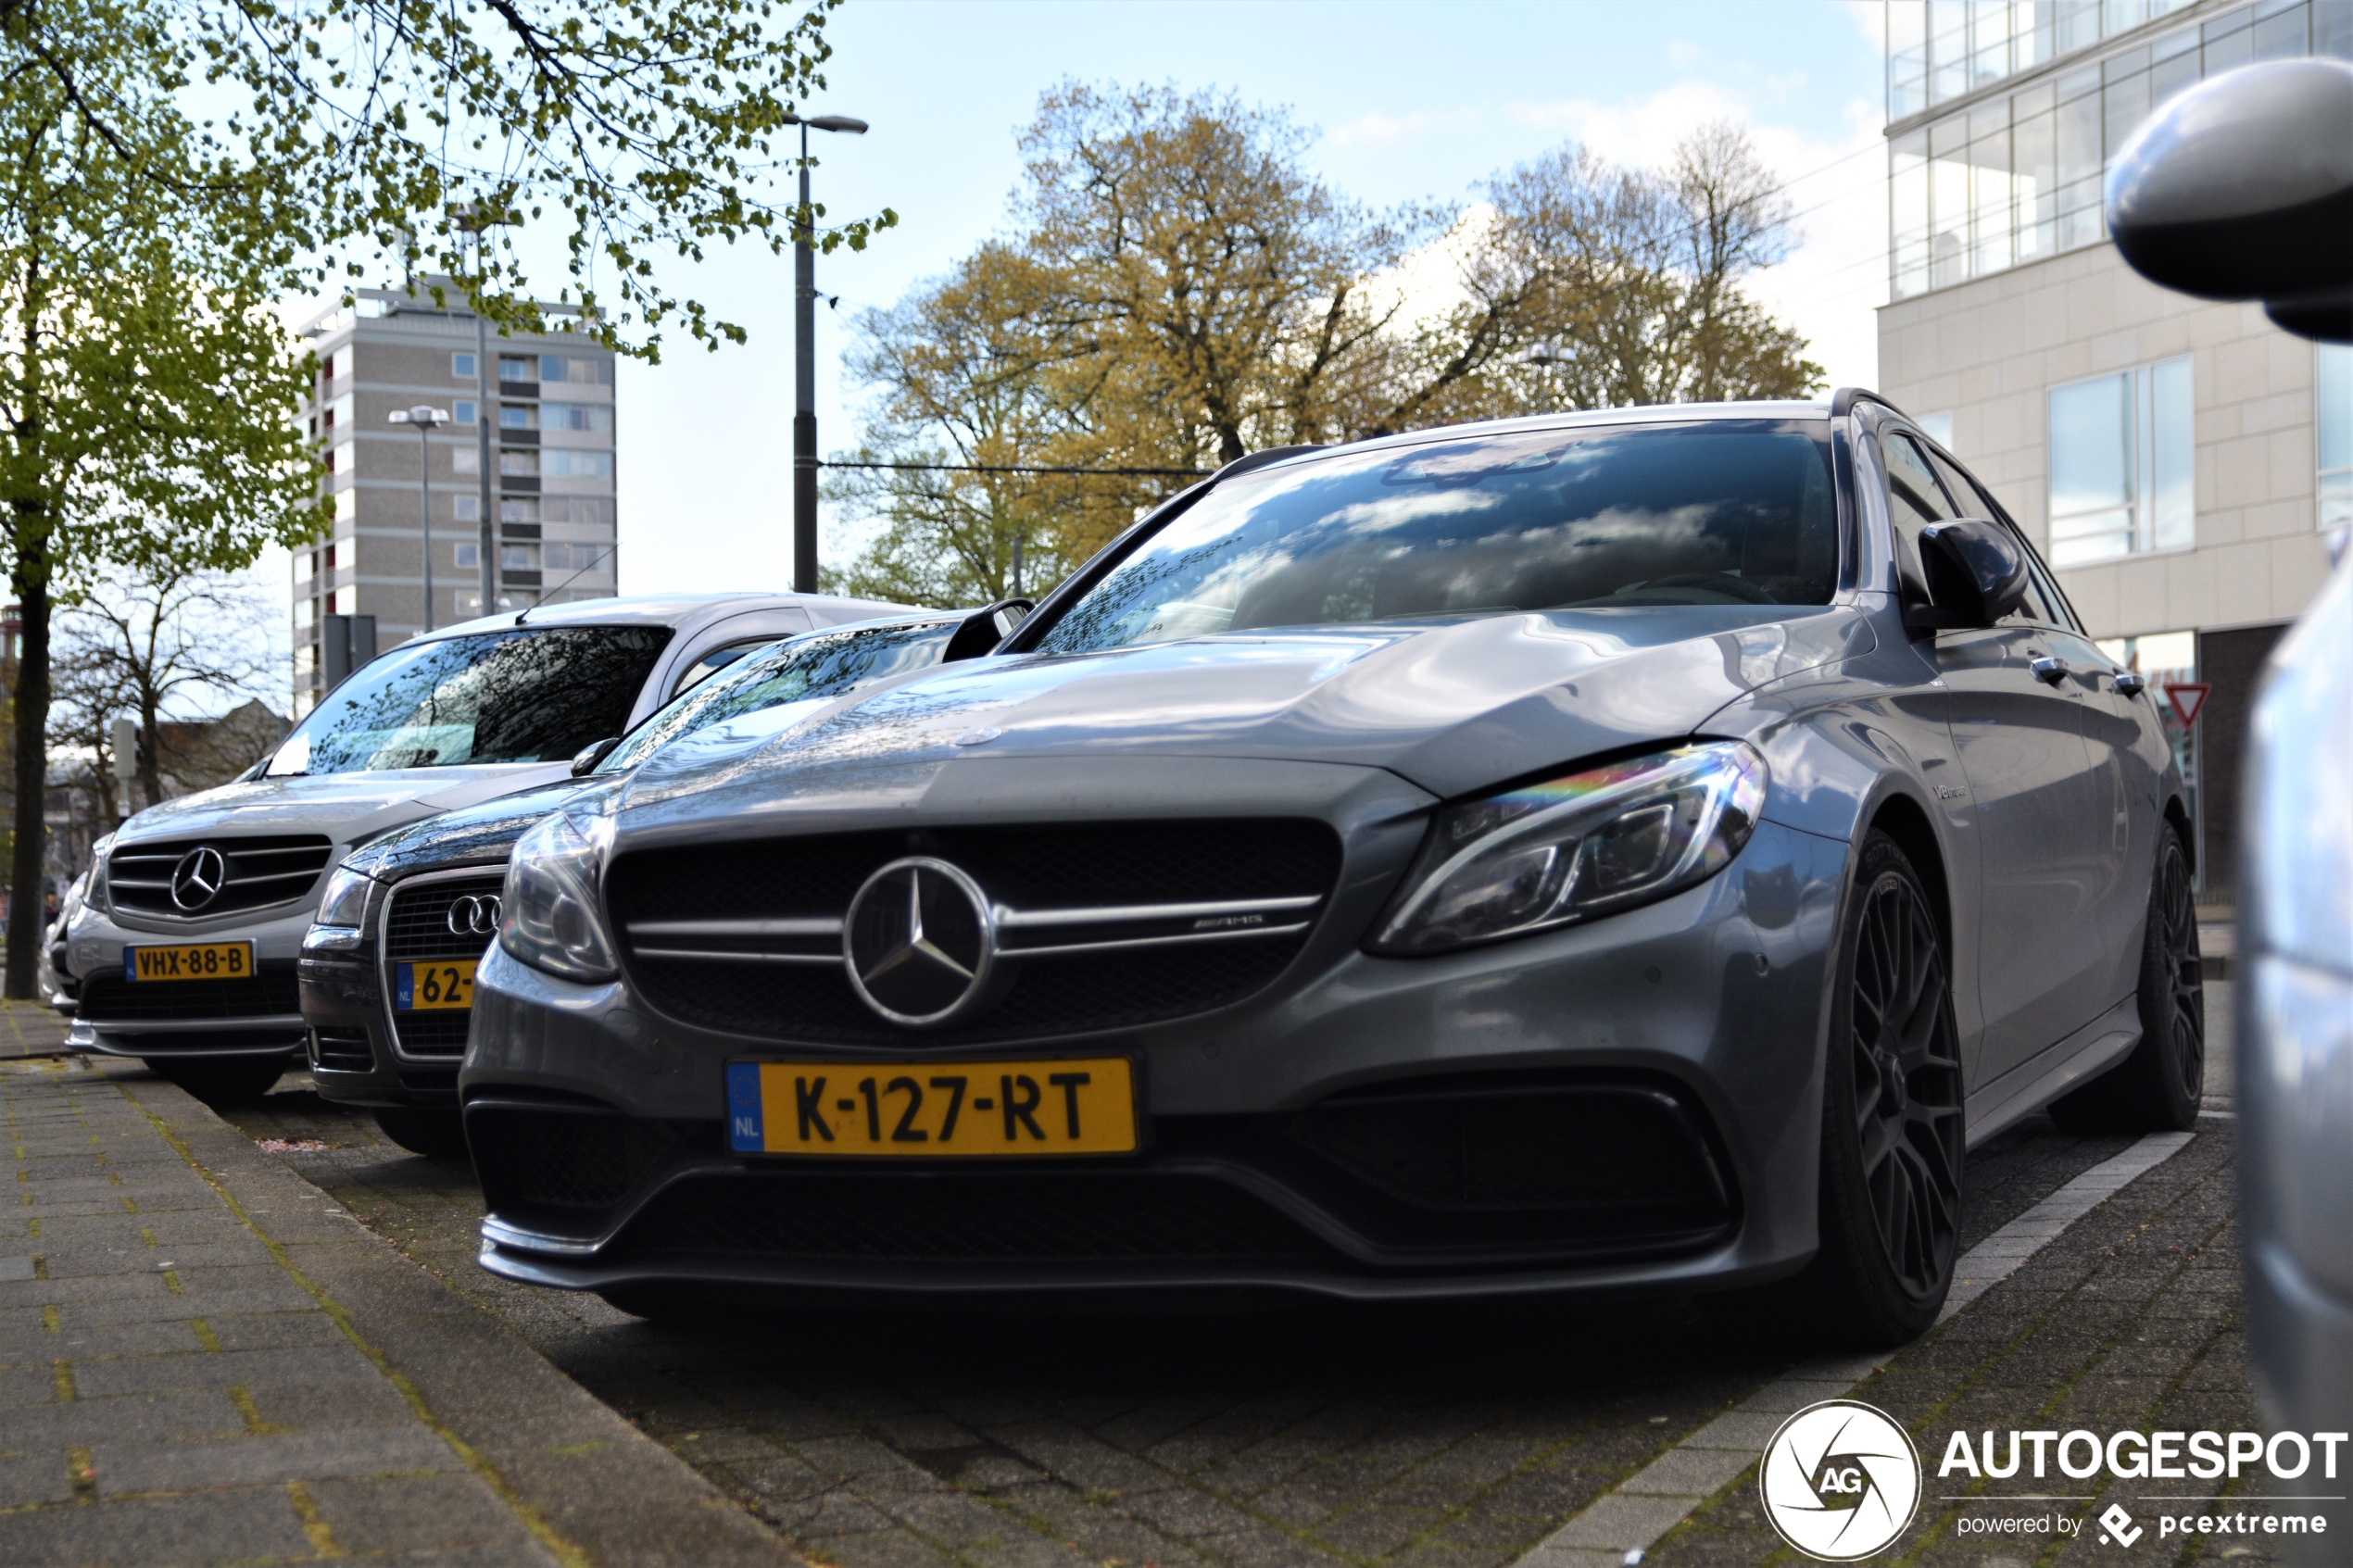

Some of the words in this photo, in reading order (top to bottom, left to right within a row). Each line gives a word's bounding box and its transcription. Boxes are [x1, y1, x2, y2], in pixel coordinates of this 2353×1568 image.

[1933, 785, 1948, 799] V8
[1215, 914, 1263, 926] AMG
[139, 947, 243, 976] VHX-88-B
[399, 992, 410, 1002] NL
[422, 967, 475, 1002] 62-
[736, 1117, 759, 1137] NL
[795, 1072, 1091, 1142] K-127-RT
